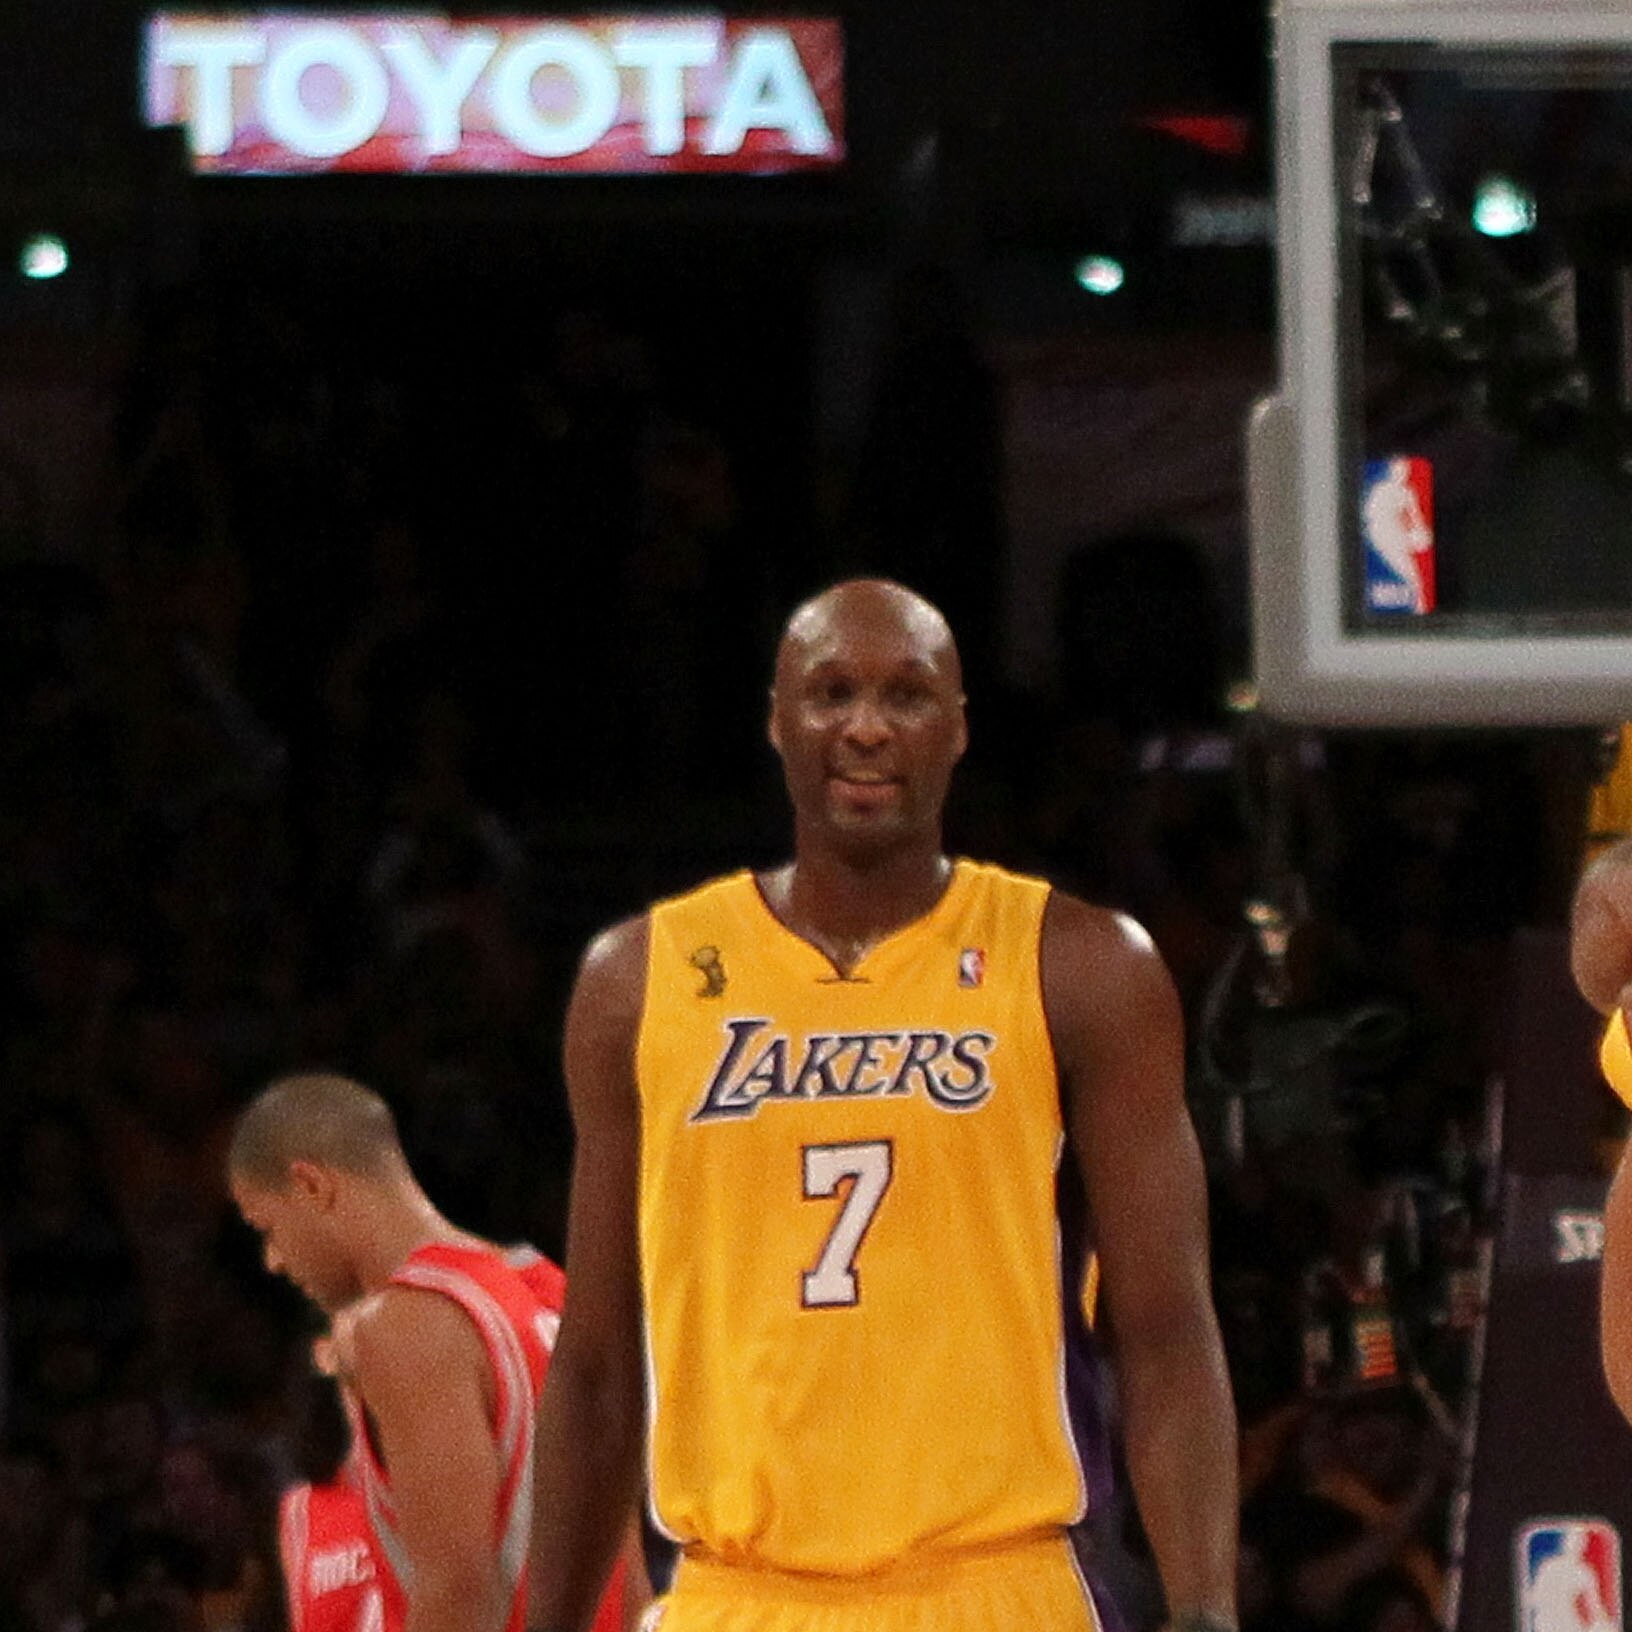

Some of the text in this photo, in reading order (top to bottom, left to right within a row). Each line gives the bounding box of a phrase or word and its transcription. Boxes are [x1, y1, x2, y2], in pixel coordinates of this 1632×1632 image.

[163, 25, 836, 158] TOYOTA
[689, 1016, 996, 1127] LAKERS
[800, 1138, 893, 1311] 7
